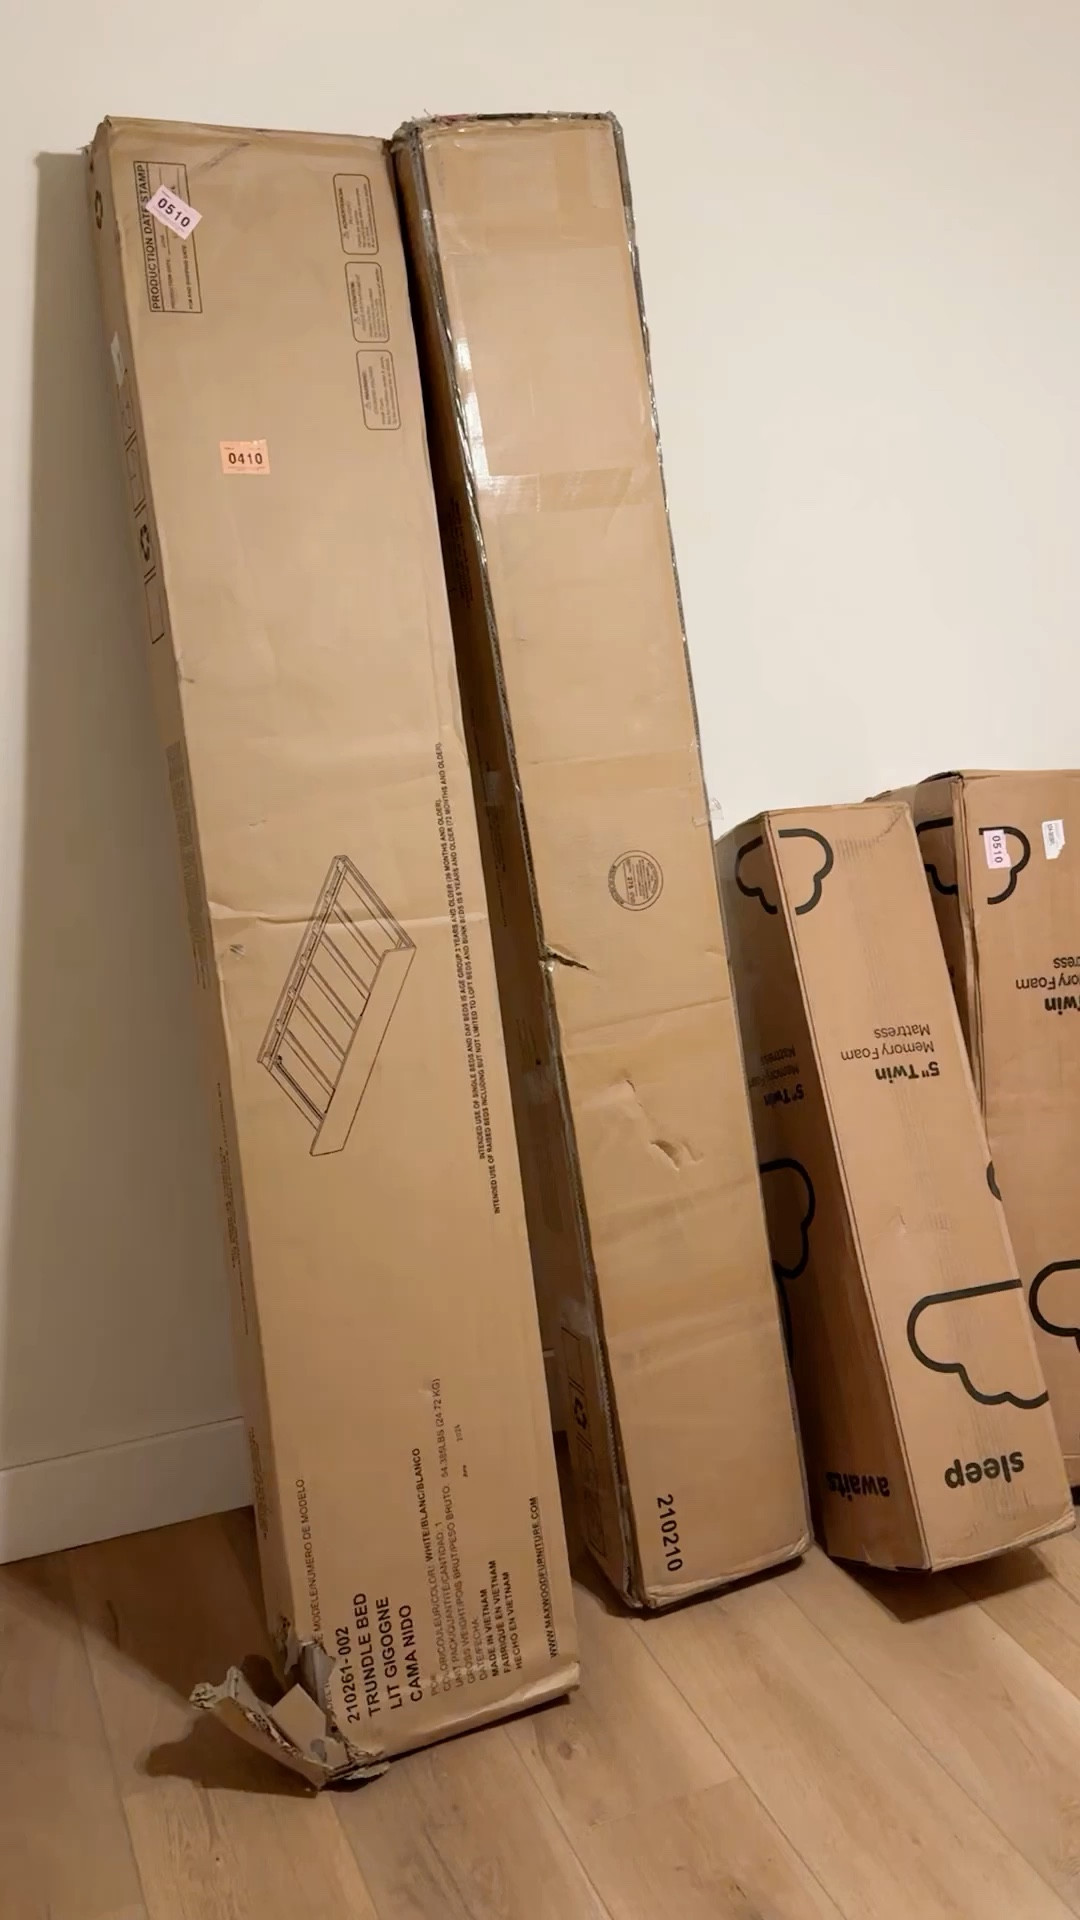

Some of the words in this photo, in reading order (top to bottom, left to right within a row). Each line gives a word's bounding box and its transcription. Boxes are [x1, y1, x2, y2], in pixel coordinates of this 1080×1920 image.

[136, 165, 148, 202] STAMP
[158, 198, 190, 227] 0510
[144, 238, 161, 308] PRODUCTION
[229, 453, 262, 464] 0410
[440, 785, 451, 814] MONTHS
[447, 827, 456, 850] OLDER
[992, 835, 1003, 863] 0510
[441, 842, 450, 870] MONTHS
[452, 867, 461, 890] YEARS
[446, 883, 455, 906] OLDER
[452, 924, 460, 946] YEARS
[460, 924, 468, 944] BUNK
[455, 953, 464, 978] GROUP
[462, 945, 470, 960] AND
[458, 979, 466, 993] AGE
[467, 981, 475, 998] LOFT
[1016, 977, 1056, 990] Foam
[1058, 973, 1080, 986] ory
[461, 1003, 469, 1021] BEDS
[469, 999, 476, 1008] TO
[471, 1010, 479, 1037] LIMITED
[873, 1024, 931, 1039] Mattress
[465, 1037, 473, 1052] AND
[840, 1048, 880, 1061] Foam
[882, 1041, 935, 1056] Memory
[467, 1054, 475, 1071] BEDS
[875, 1064, 919, 1084] Twin
[470, 1074, 479, 1098] SINGLE
[478, 1069, 487, 1105] INCLUDING
[472, 1099, 479, 1109] OF
[475, 1125, 485, 1159] INTENDED
[484, 1127, 493, 1152] RAISED
[487, 1154, 494, 1163] OF
[490, 1180, 500, 1213] INTENDED
[944, 1451, 1024, 1489] sleep
[826, 1471, 891, 1502] awaits
[294, 1478, 310, 1523] MODELO
[412, 1447, 432, 1561] WHITE/BLANC/BLANCO
[300, 1525, 312, 1540] DE
[656, 1494, 684, 1573] 210210
[446, 1522, 461, 1578] BRUT/PESO
[488, 1560, 501, 1604] VIETNAM
[529, 1497, 558, 1657] WWW.MAXWOODFURNITURE.COM
[502, 1571, 514, 1615] VIETNAM
[352, 1592, 369, 1629] BED
[479, 1588, 492, 1632] VIETNAM
[494, 1606, 502, 1619] EN
[397, 1603, 416, 1647] NIDO
[508, 1617, 516, 1630] EN
[375, 1596, 397, 1678] GIGOGNE
[485, 1634, 493, 1644] IN
[487, 1647, 499, 1676] MADE
[510, 1632, 523, 1669] HECHO
[334, 1625, 361, 1723] 210261-002
[357, 1632, 381, 1716] TRUNDLE
[404, 1649, 423, 1702] CAMA
[387, 1683, 402, 1709] LIT
